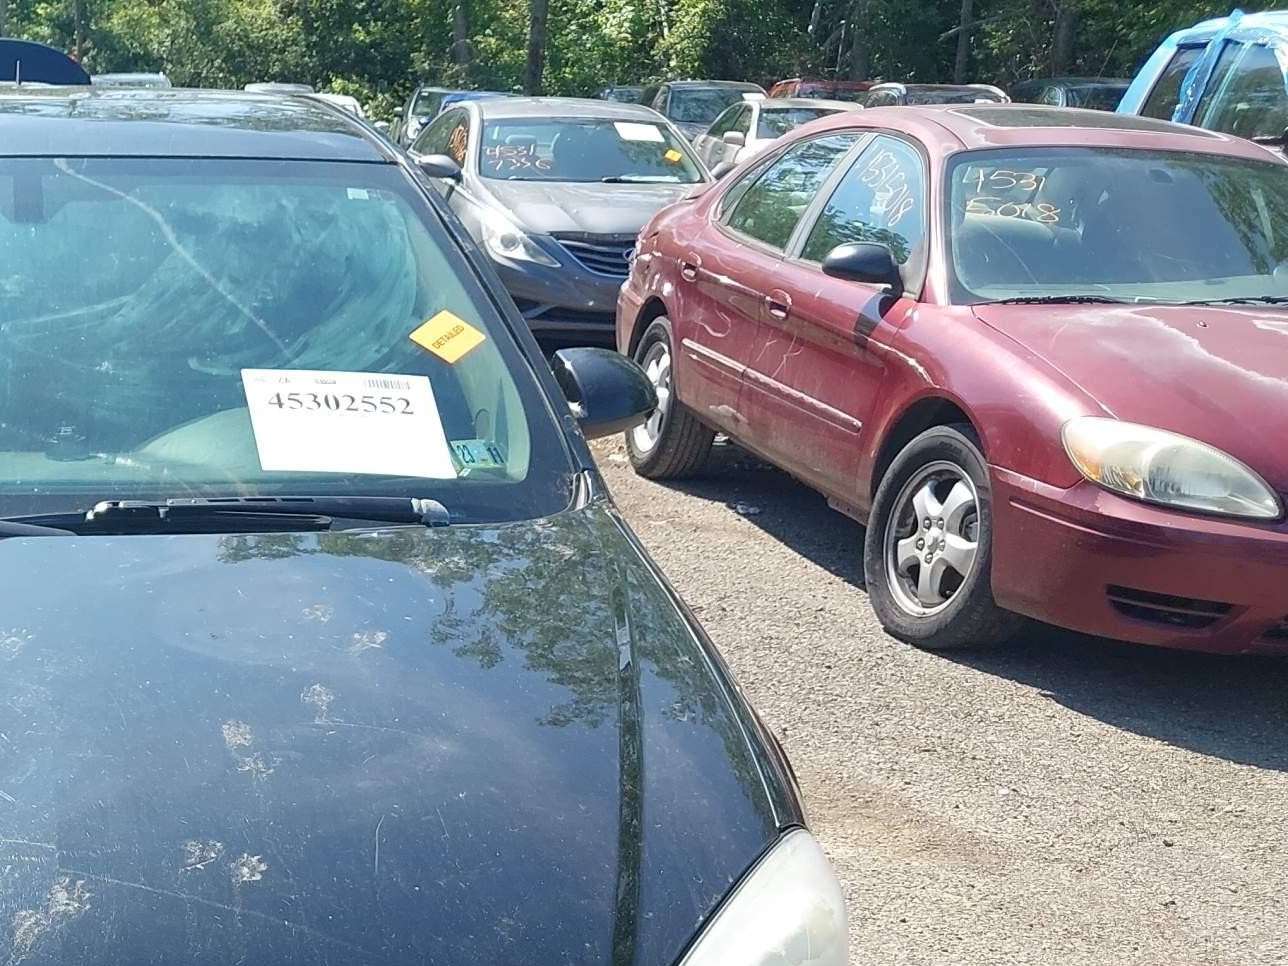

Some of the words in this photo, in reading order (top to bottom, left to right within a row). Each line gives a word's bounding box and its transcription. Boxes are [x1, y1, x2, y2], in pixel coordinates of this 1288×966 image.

[962, 166, 1046, 193] 4531
[431, 324, 465, 350] DETAILED
[267, 391, 415, 416] 45302552
[456, 444, 476, 464] 23
[486, 446, 505, 465] 11
